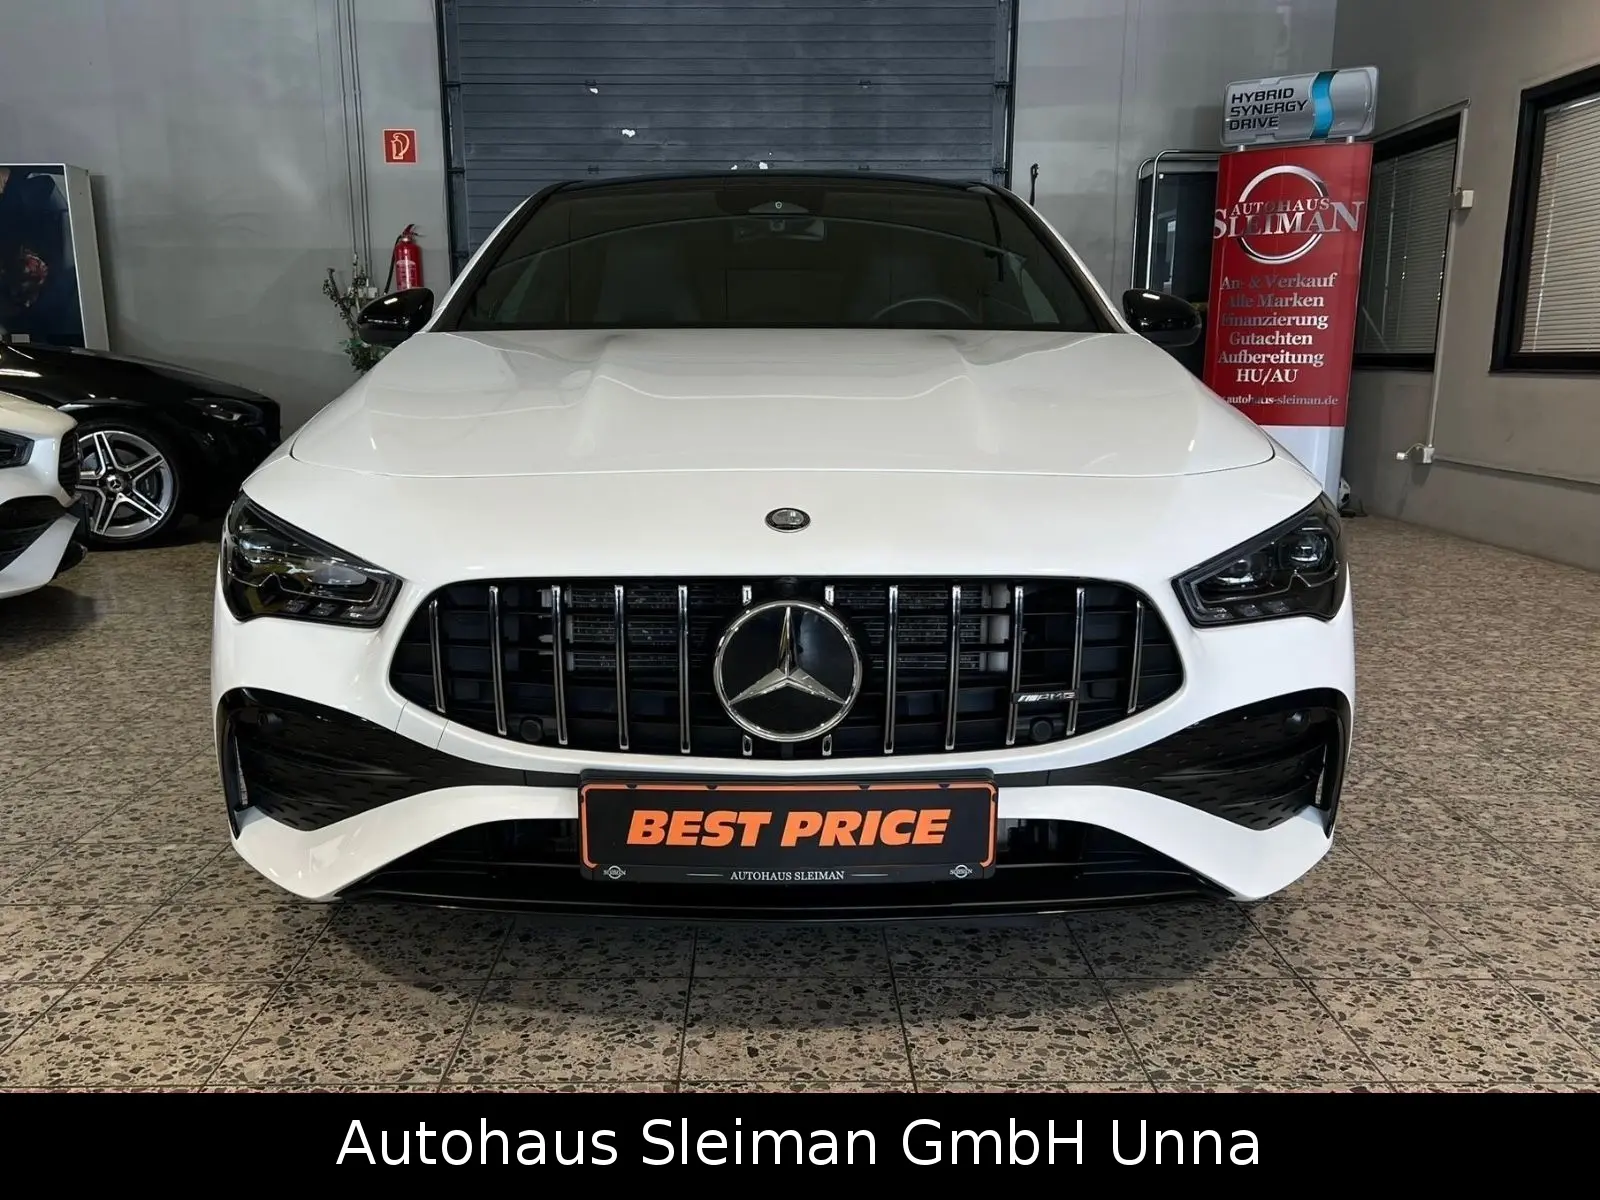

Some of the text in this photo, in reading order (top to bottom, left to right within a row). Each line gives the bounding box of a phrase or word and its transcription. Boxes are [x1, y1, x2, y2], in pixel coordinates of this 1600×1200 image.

[1231, 87, 1294, 104] HYBRID
[1230, 99, 1308, 118] SYNERGY
[1229, 116, 1279, 131] DRIVE
[1231, 198, 1330, 216] AUTOHAUS
[1213, 201, 1365, 239] SLEIMAN
[1264, 272, 1338, 288] Verkauf
[1257, 292, 1324, 308] Marken
[1229, 331, 1313, 346] Gutachten
[1218, 349, 1324, 367] Aufbereitung
[1236, 368, 1299, 385] HU/AU
[626, 808, 951, 847] BEST PRICE
[730, 870, 845, 881] AUTOHAUS SLEIMAN
